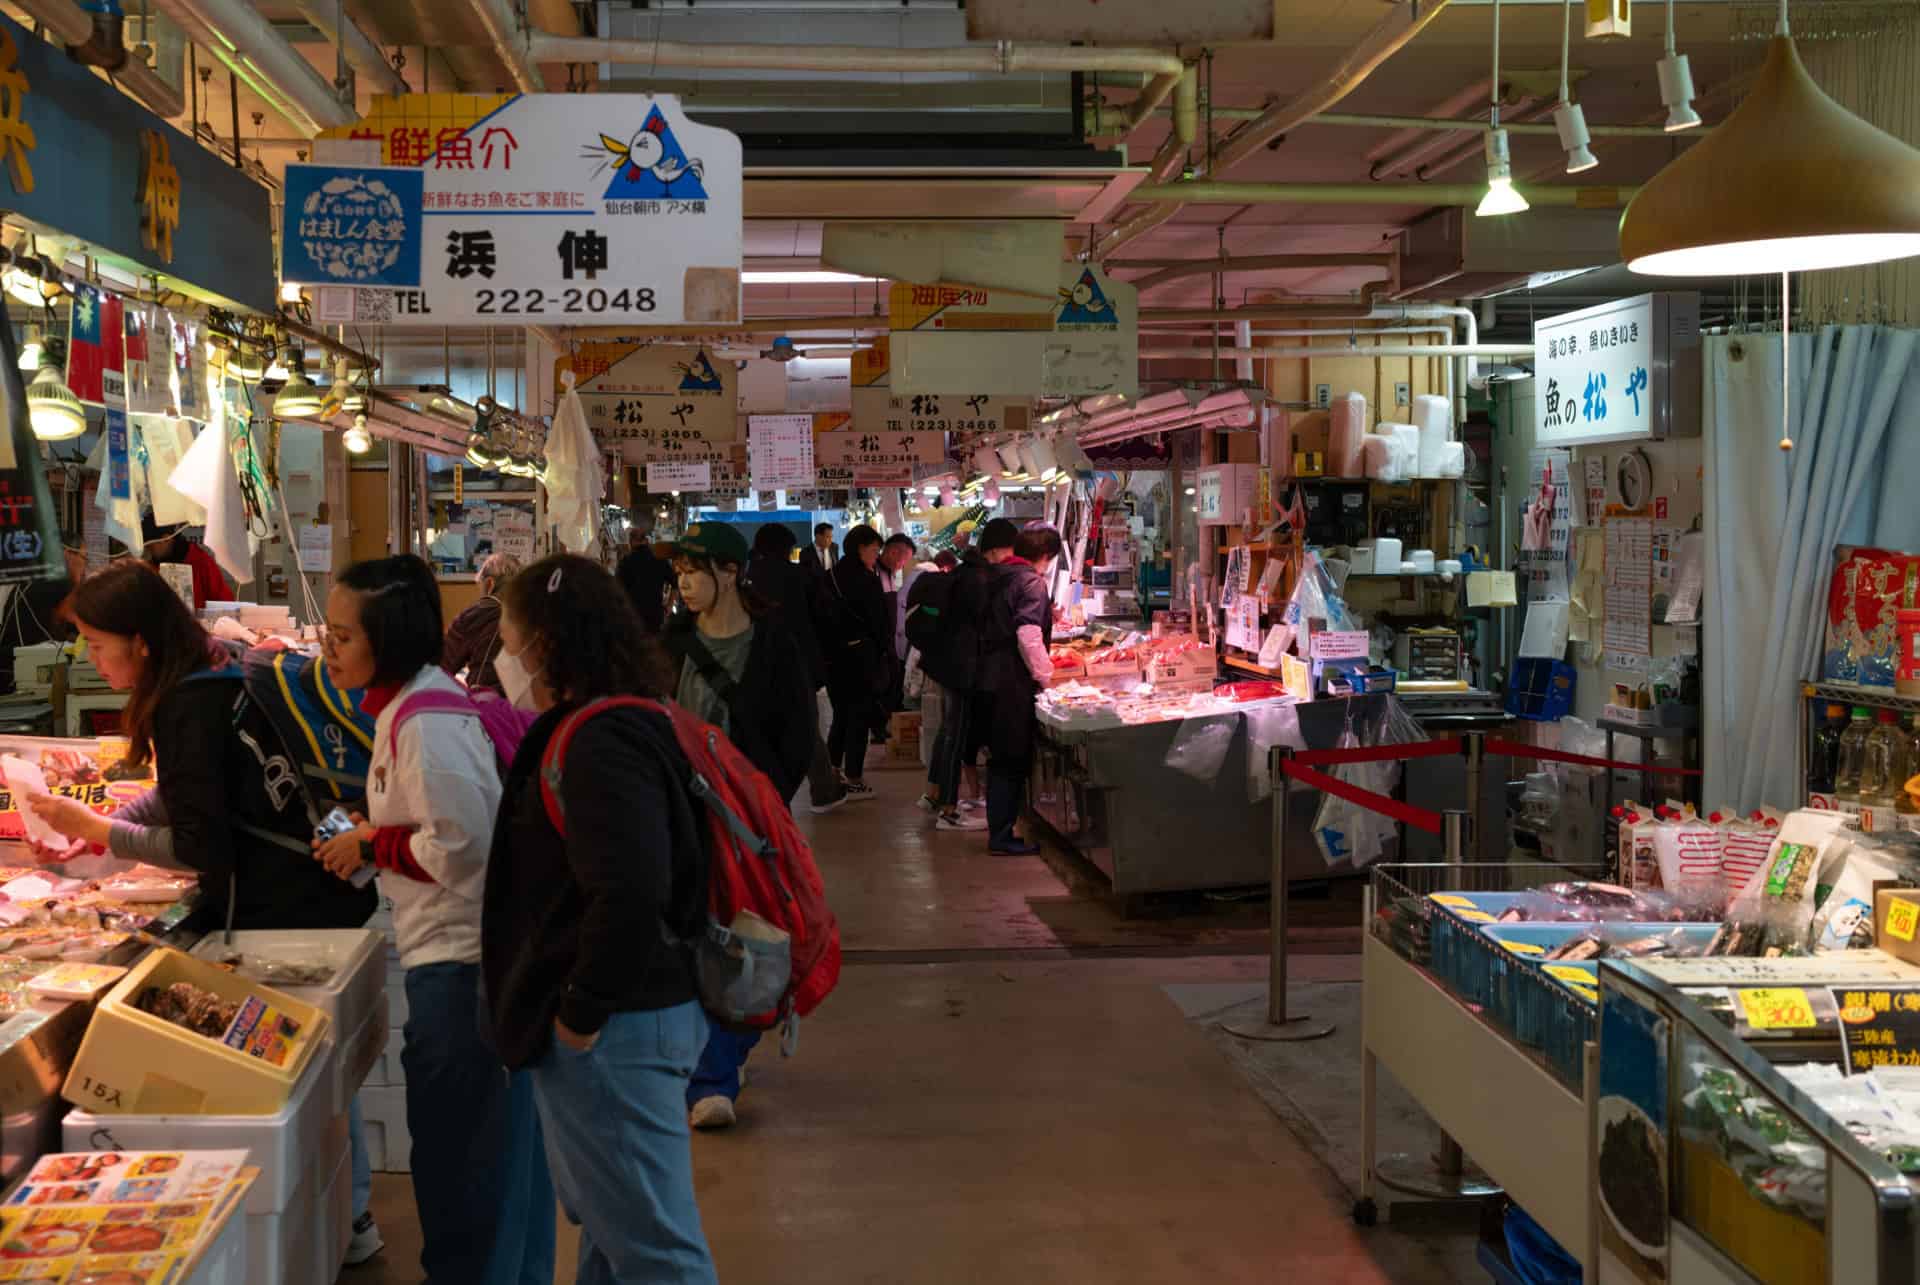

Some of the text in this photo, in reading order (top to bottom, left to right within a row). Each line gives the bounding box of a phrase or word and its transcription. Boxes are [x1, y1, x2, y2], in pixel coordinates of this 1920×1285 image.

[350, 127, 518, 170] 鮮魚介
[605, 200, 660, 215] 仙台朝市
[394, 287, 657, 316] TEL 222-2048
[887, 420, 903, 431] TEL
[910, 420, 952, 431] (223)
